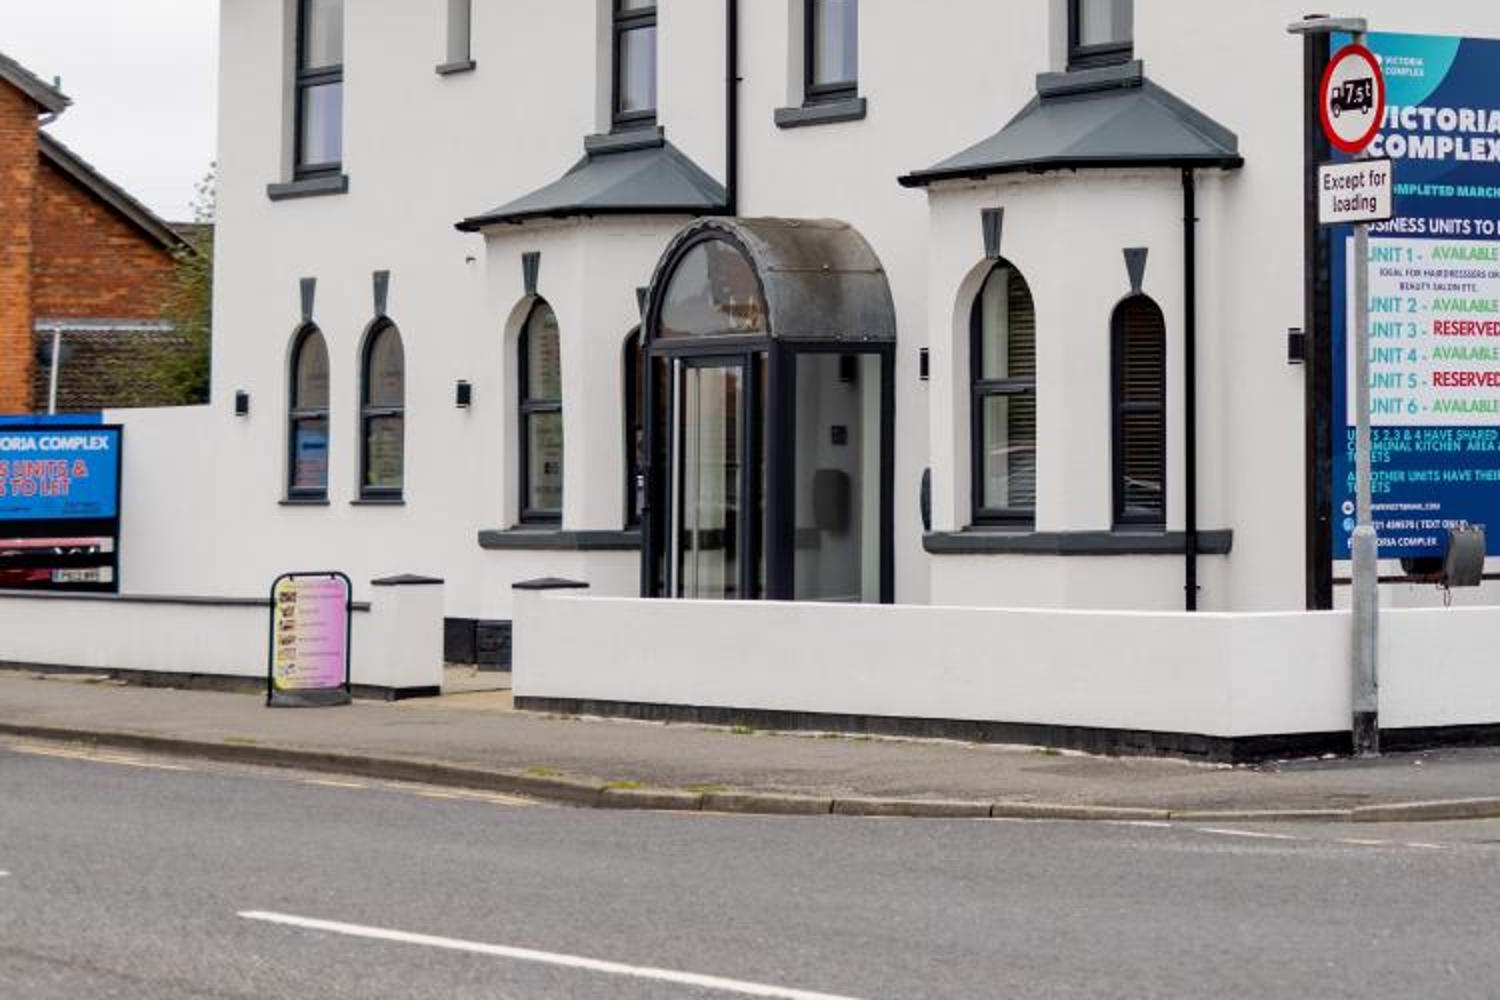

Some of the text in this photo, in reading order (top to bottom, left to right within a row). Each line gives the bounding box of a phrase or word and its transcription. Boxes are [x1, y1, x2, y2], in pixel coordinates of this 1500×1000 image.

[1385, 67, 1424, 76] COMPLEX
[1324, 170, 1387, 192] Except for
[1393, 184, 1454, 197] MPLETED
[1456, 185, 1500, 197] MARCH
[1333, 195, 1377, 213] loading
[1429, 219, 1471, 234] UNITS
[1473, 220, 1496, 235] TO
[1405, 247, 1413, 262] 1
[1431, 247, 1499, 261] AVAILABLE
[1405, 269, 1421, 277] FOR
[1407, 298, 1417, 313] 2
[1431, 298, 1499, 312] AVAILABLE
[1407, 323, 1417, 338] 3
[1407, 348, 1417, 363] 4
[1431, 345, 1499, 361] AVAILABLE
[1407, 373, 1417, 388] 5
[1407, 399, 1418, 413] 6
[1431, 398, 1499, 413] AVAILABLE
[40, 435, 109, 450] COMPLEX
[1414, 430, 1421, 441] 4
[1423, 430, 1453, 440] HAVE
[1456, 429, 1498, 440] SHARED
[1415, 440, 1461, 451] KITCHEN
[1466, 440, 1496, 450] AREA
[13, 460, 69, 477] UNITS
[72, 458, 88, 477] &
[1370, 471, 1406, 482] OTHER
[1408, 470, 1440, 481] UNITS
[1443, 470, 1473, 481] HAVE
[11, 478, 37, 496] TO
[40, 478, 71, 496] LET
[1397, 538, 1437, 547] COMPLEX
